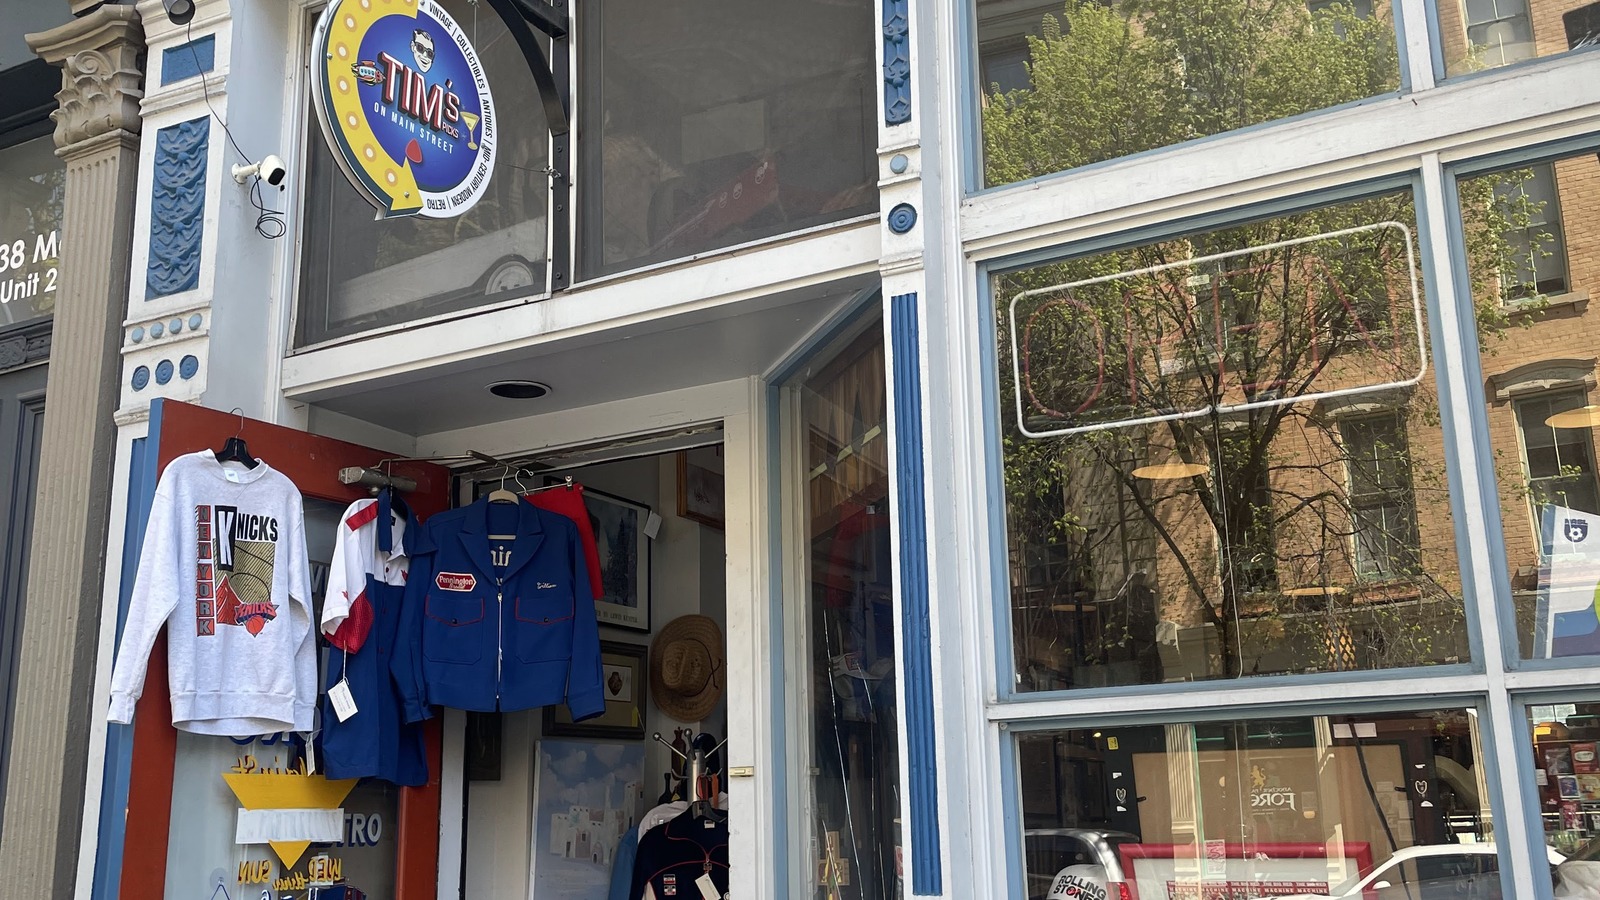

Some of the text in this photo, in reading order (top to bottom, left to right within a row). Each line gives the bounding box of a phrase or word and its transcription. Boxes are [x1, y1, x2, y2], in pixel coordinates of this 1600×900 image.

[429, 2, 453, 31] VINTAGE
[456, 34, 486, 90] COLLECTIBLES
[374, 101, 454, 154] ON MAIN STREET
[442, 121, 459, 139] PICKS
[482, 99, 493, 139] ANTIQUES
[427, 198, 446, 210] RETRO
[450, 184, 475, 208] MODERN
[33, 230, 62, 264] M
[0, 267, 58, 304] Unit 2
[198, 505, 214, 635] NEW YORK
[439, 576, 475, 588] Pennington
[237, 602, 276, 619] KNICKS
[1053, 884, 1107, 900] STONE
[1058, 875, 1107, 900] ROLLING
